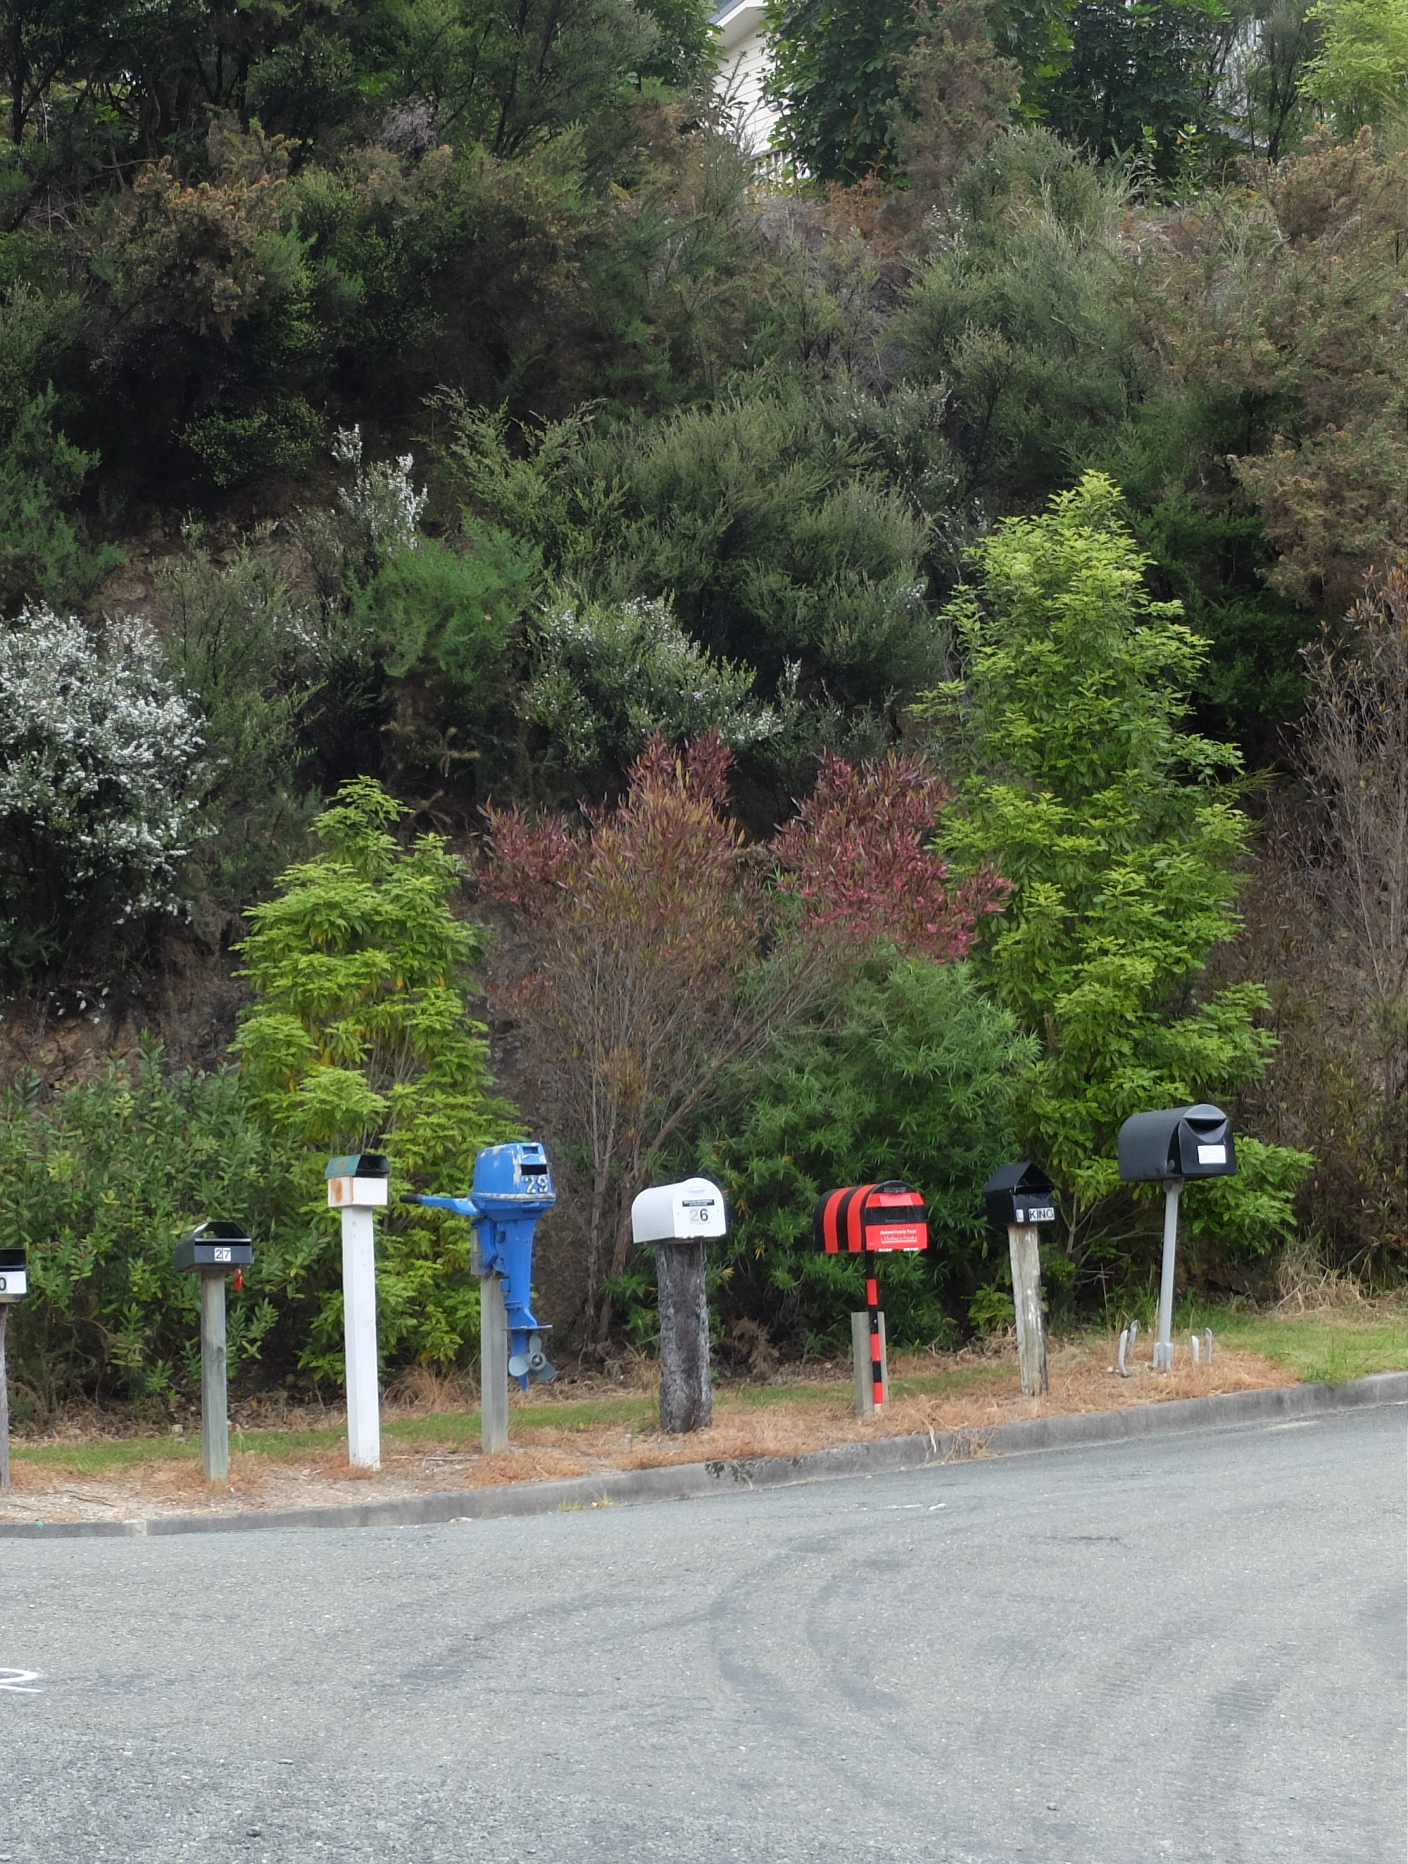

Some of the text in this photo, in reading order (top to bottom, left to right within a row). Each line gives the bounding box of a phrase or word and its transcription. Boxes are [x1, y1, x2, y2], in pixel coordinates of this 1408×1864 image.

[524, 1175, 549, 1194] 29
[689, 1208, 709, 1222] 26
[1029, 1208, 1054, 1220] KING
[215, 1248, 231, 1260] 27
